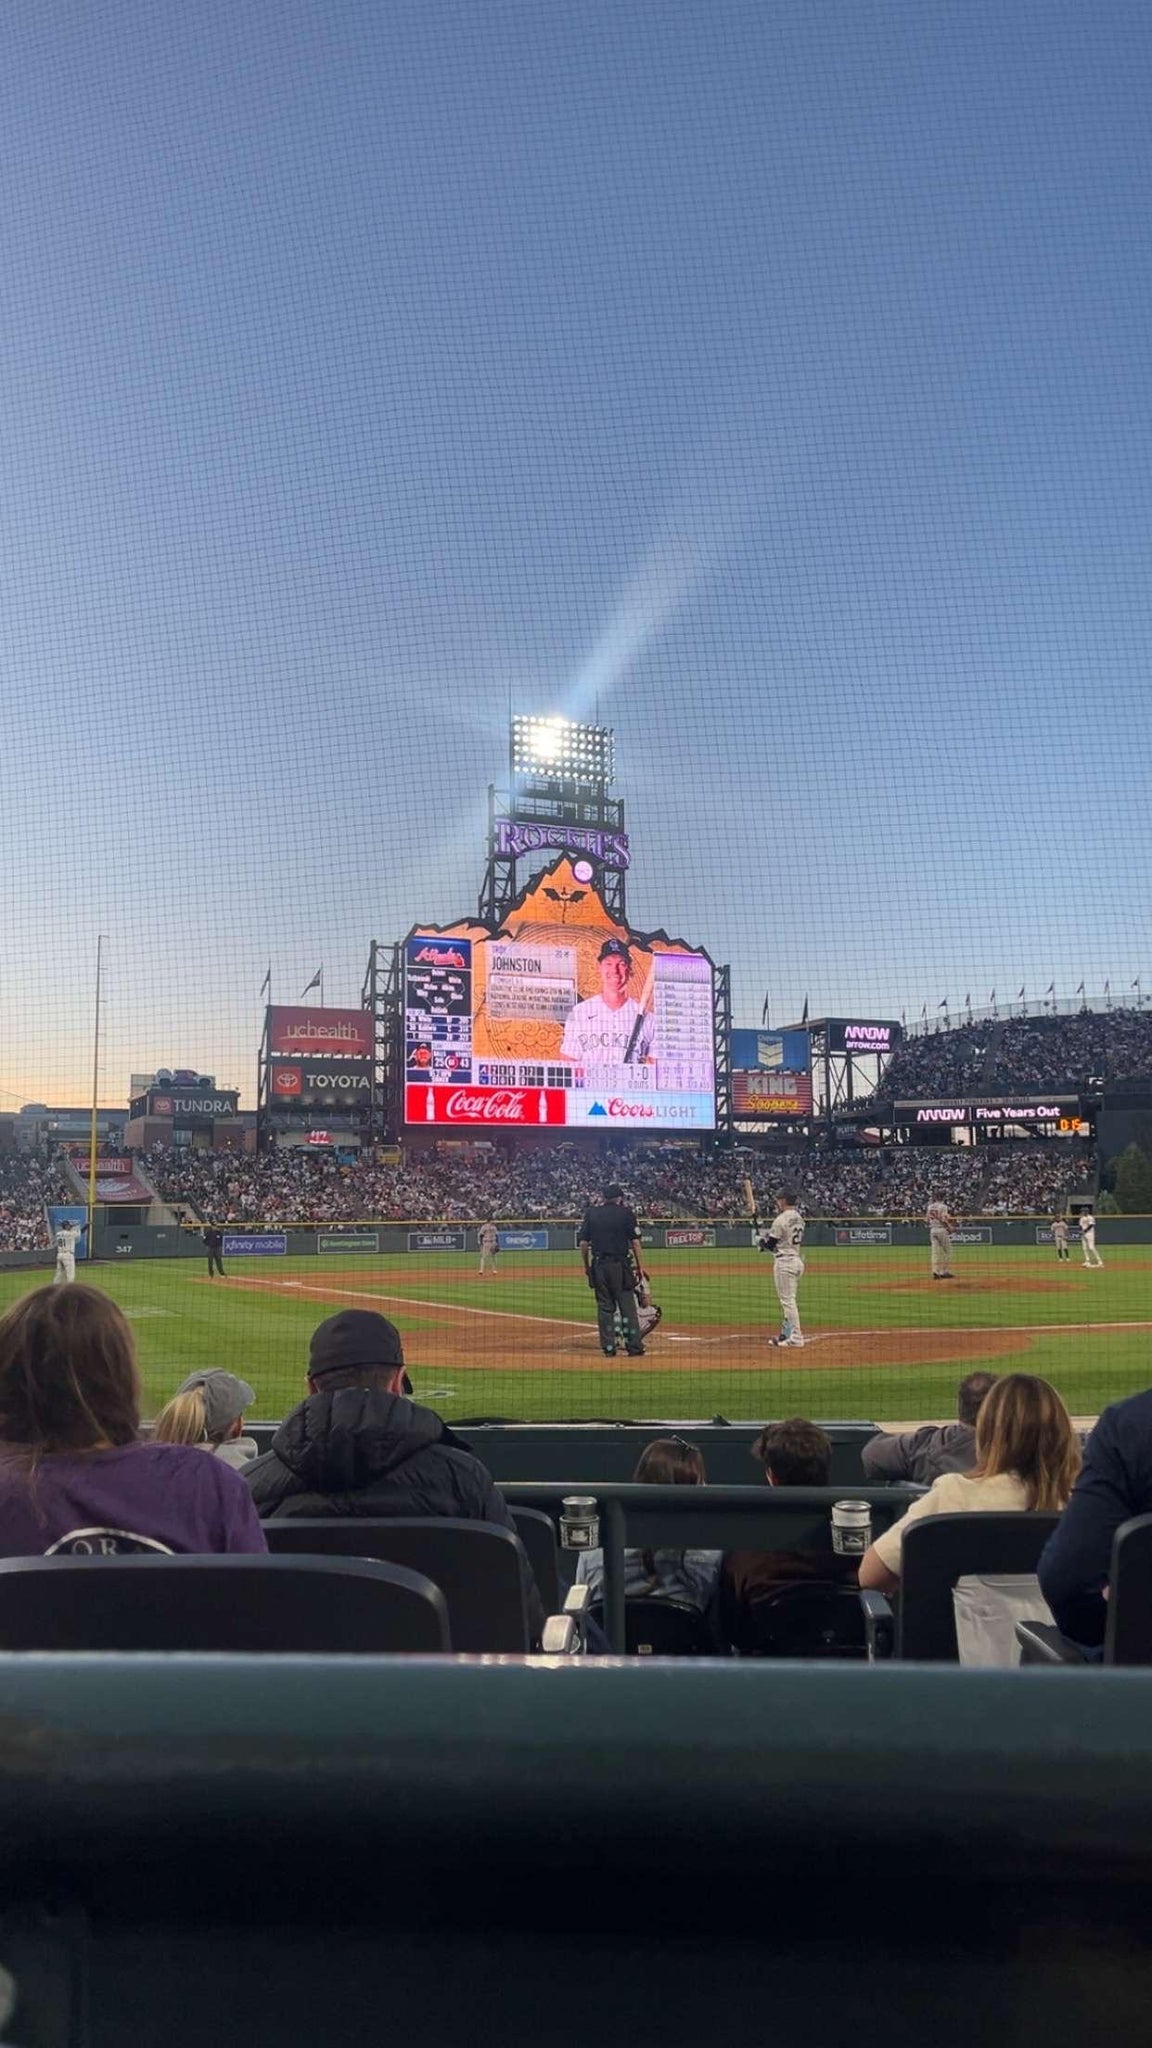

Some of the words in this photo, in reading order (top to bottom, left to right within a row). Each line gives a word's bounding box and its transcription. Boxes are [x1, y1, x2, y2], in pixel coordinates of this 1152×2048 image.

[494, 822, 632, 868] ROCKIES
[492, 957, 541, 973] JOHNSTON
[287, 1019, 358, 1040] uchealth
[845, 1025, 890, 1041] ARROW
[846, 1041, 890, 1050] arrow.com
[434, 1058, 445, 1068] 25
[460, 1058, 470, 1069] 43
[306, 1074, 371, 1089] TOYOTA
[746, 1076, 798, 1095] KING
[173, 1099, 233, 1113] TUNDRA
[446, 1090, 527, 1119] Coca-Cola
[608, 1097, 654, 1118] Coors
[655, 1105, 696, 1118] LIGHT
[917, 1108, 966, 1122] ARROW
[976, 1108, 1001, 1119] Five
[1002, 1107, 1036, 1118] Years
[1037, 1106, 1061, 1117] Out
[849, 1230, 887, 1240] Lifetime
[115, 1245, 133, 1254] 347
[224, 1239, 254, 1251] xfinity
[256, 1238, 286, 1250] mobile
